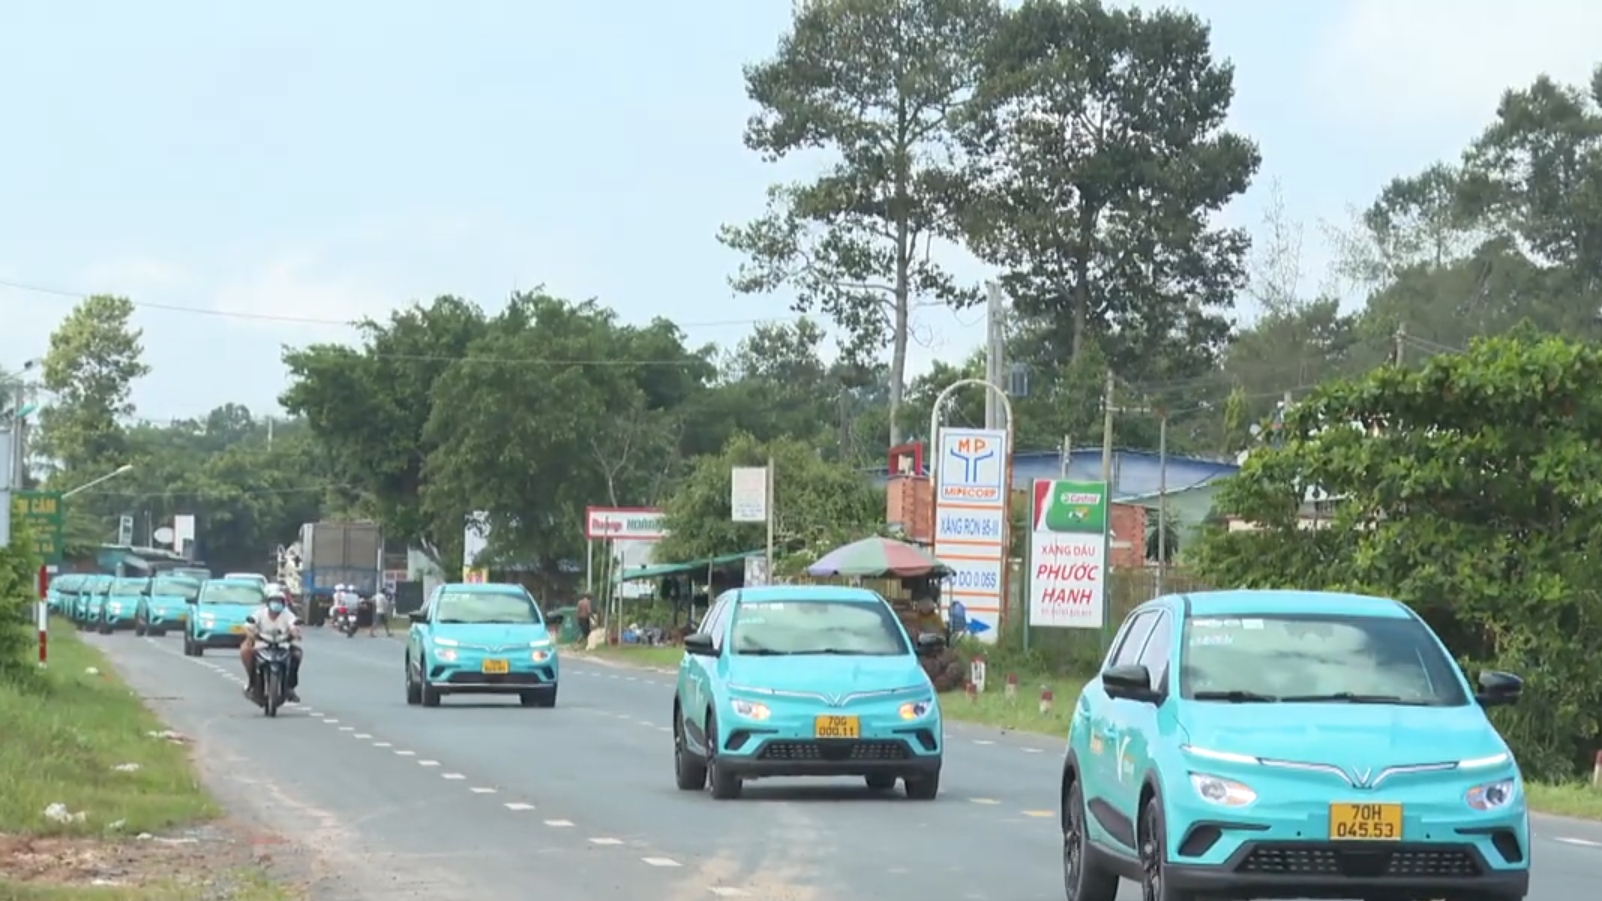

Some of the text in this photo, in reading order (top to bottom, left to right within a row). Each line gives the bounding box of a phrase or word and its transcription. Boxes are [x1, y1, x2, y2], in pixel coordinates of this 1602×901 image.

[944, 487, 997, 499] MIPECORP
[964, 518, 981, 536] RON
[958, 571, 973, 587] DO
[1036, 561, 1099, 581] PHƯỚC
[1041, 587, 1093, 607] HẠNH
[818, 726, 854, 736] 000.11
[1351, 804, 1383, 821] 70H
[1337, 821, 1395, 838] 045.53
